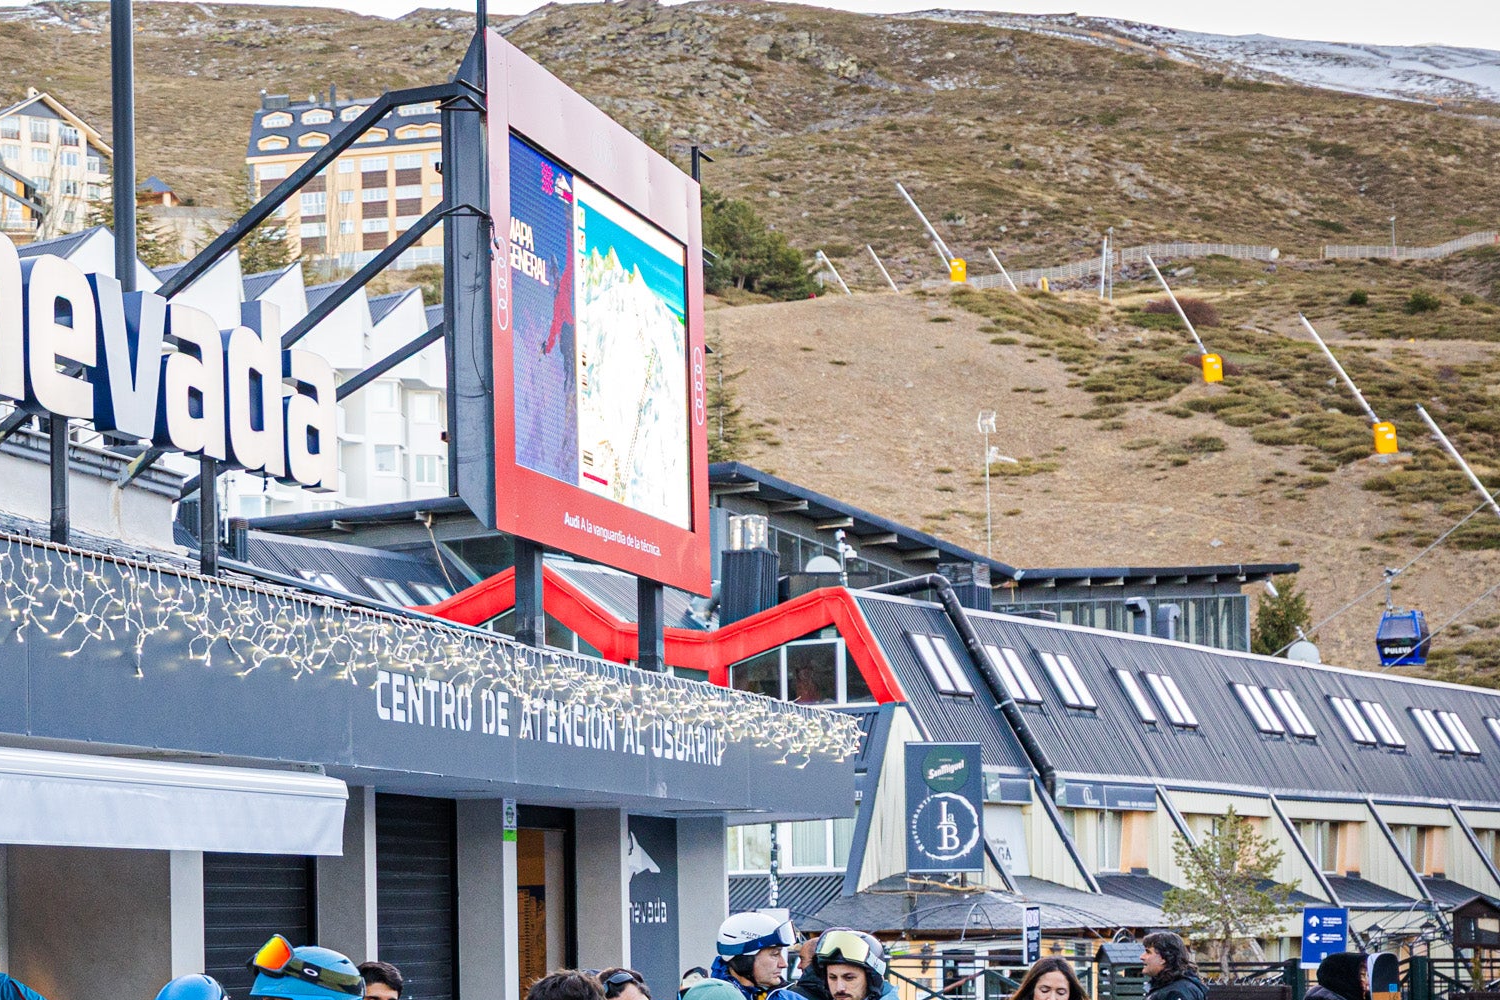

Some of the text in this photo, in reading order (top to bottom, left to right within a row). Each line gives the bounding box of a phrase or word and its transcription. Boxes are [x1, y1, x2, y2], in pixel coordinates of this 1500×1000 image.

[564, 511, 580, 530] Audi
[586, 519, 593, 533] la
[593, 524, 627, 543] vanguardia
[627, 533, 634, 548] de
[376, 669, 472, 732] CENTRO
[481, 687, 510, 737] DE
[622, 712, 646, 756] AL
